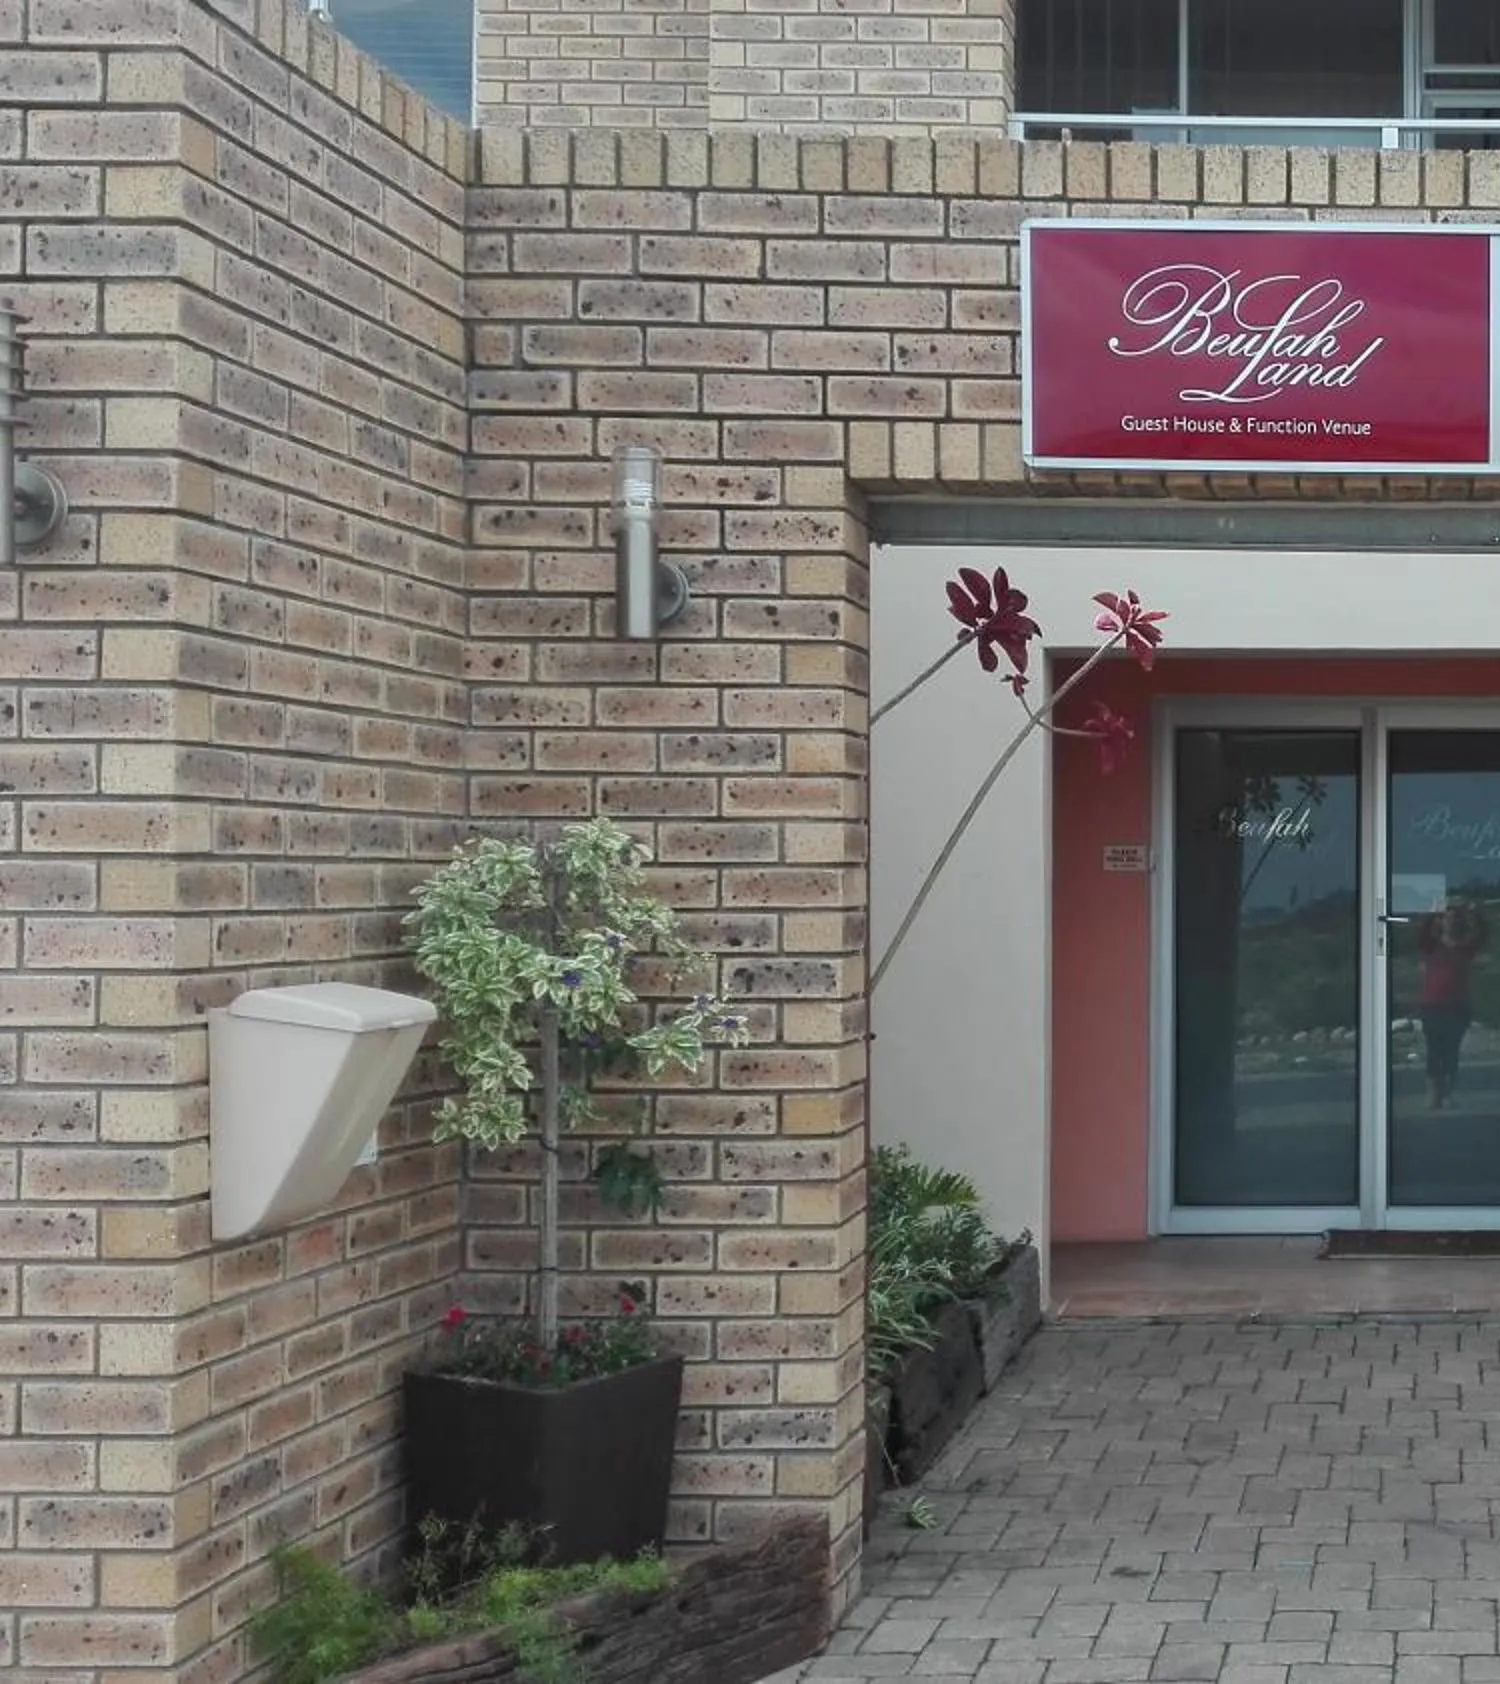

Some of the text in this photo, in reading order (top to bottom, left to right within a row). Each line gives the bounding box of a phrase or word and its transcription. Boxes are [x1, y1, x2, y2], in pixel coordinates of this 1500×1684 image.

[1108, 263, 1366, 357] Beulah
[1121, 415, 1372, 435] Guest House & Function Venue
